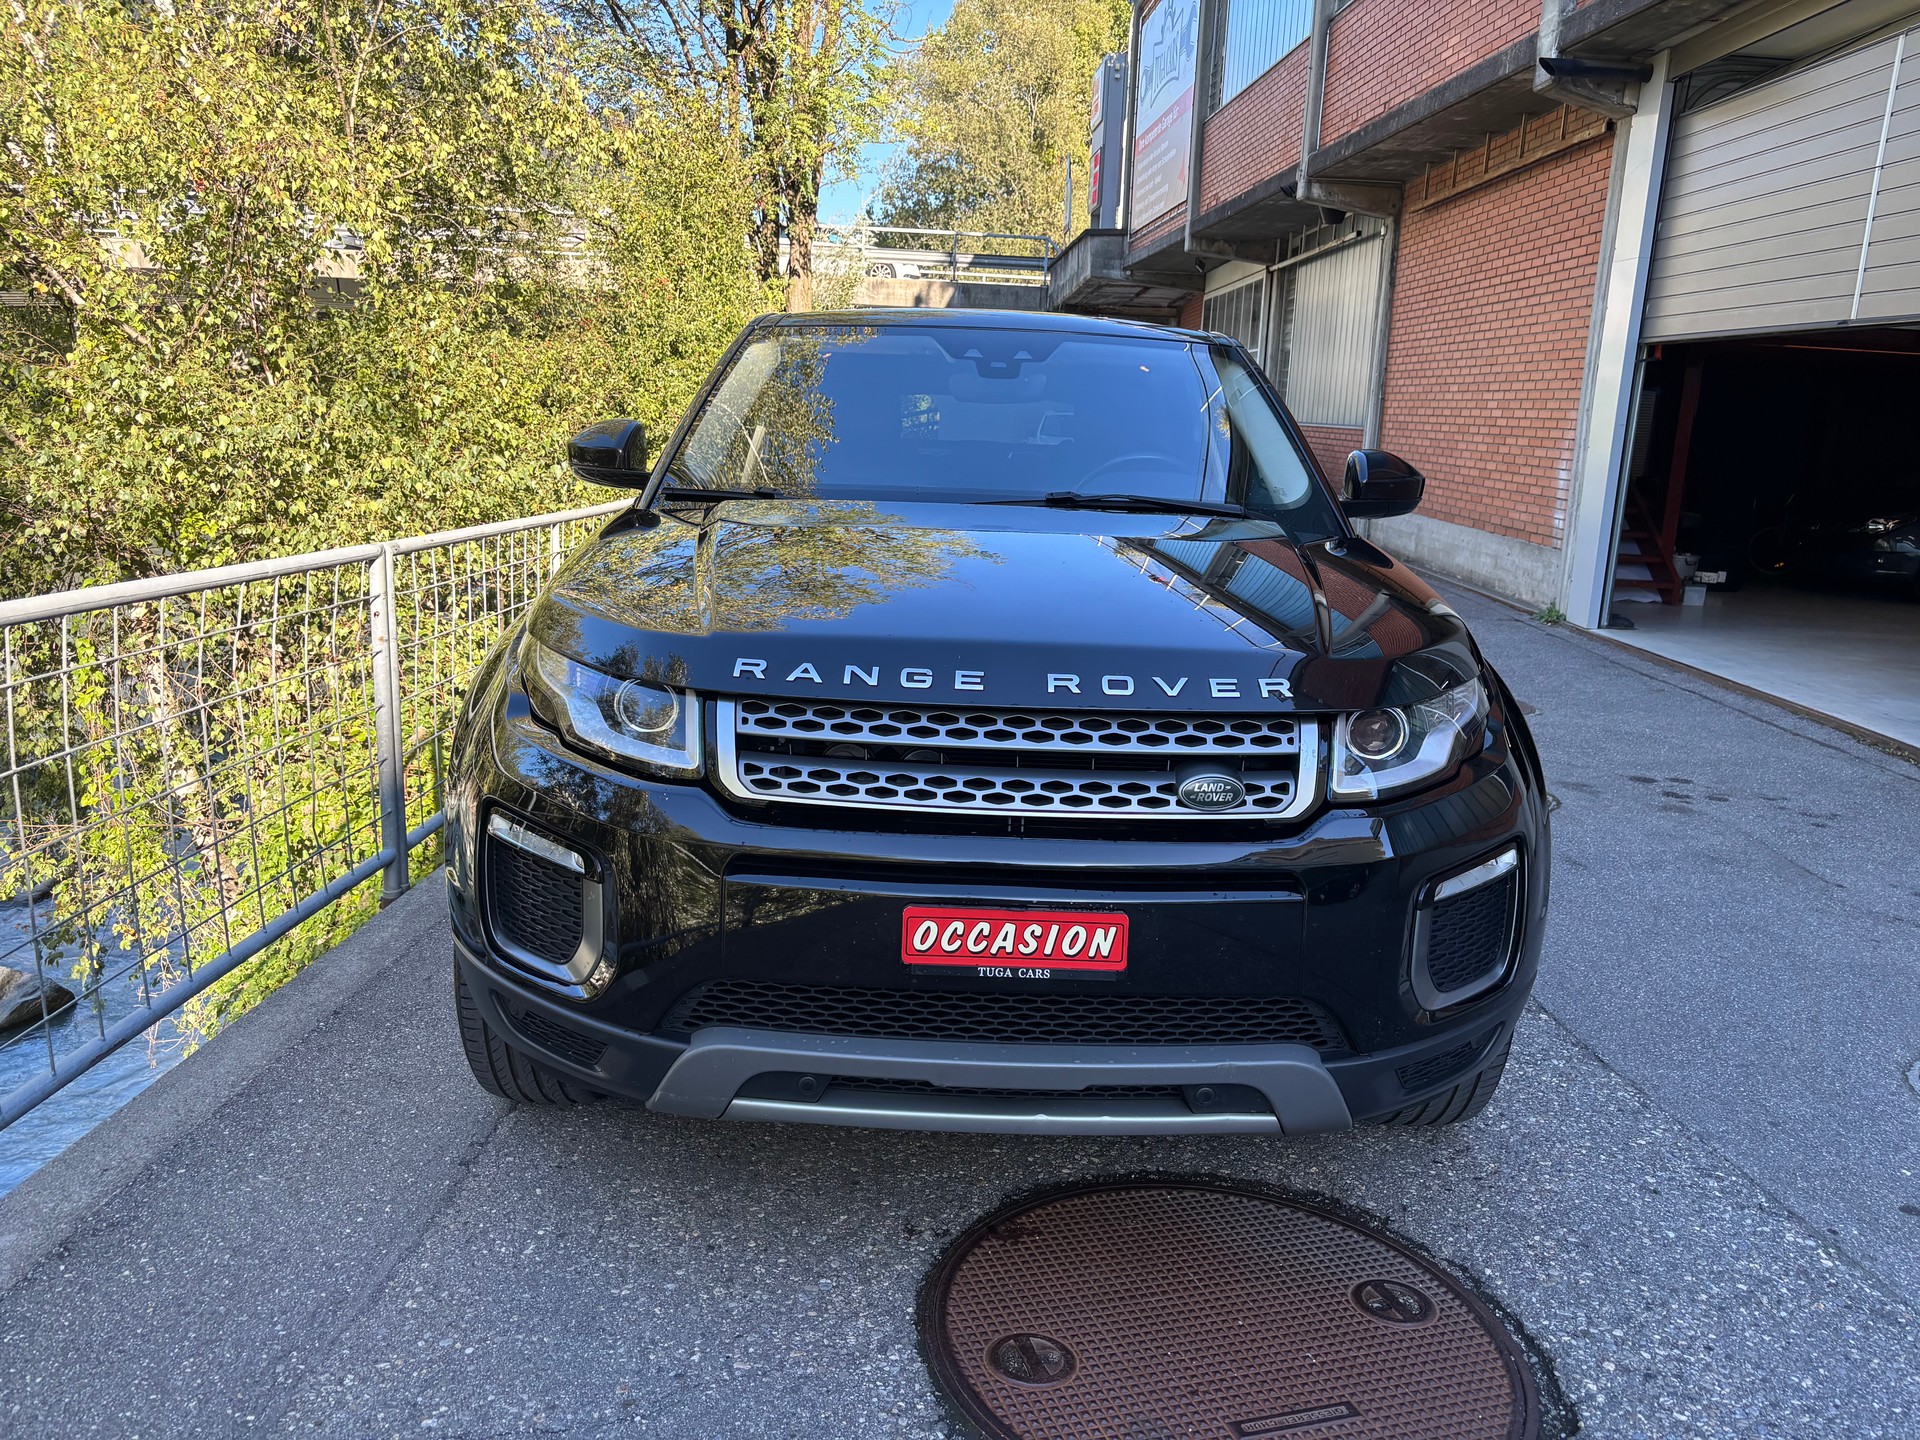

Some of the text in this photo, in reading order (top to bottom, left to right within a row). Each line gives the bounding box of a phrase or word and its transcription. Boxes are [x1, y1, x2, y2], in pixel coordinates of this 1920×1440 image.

[732, 657, 1295, 699] RANGE ROVER
[1194, 783, 1225, 792] LAND
[1196, 792, 1234, 802] ROVER
[911, 920, 1118, 959] OCCASION
[977, 966, 1051, 979] TUGA CARS
[1244, 1406, 1345, 1432] GIESSEREI CHUR
